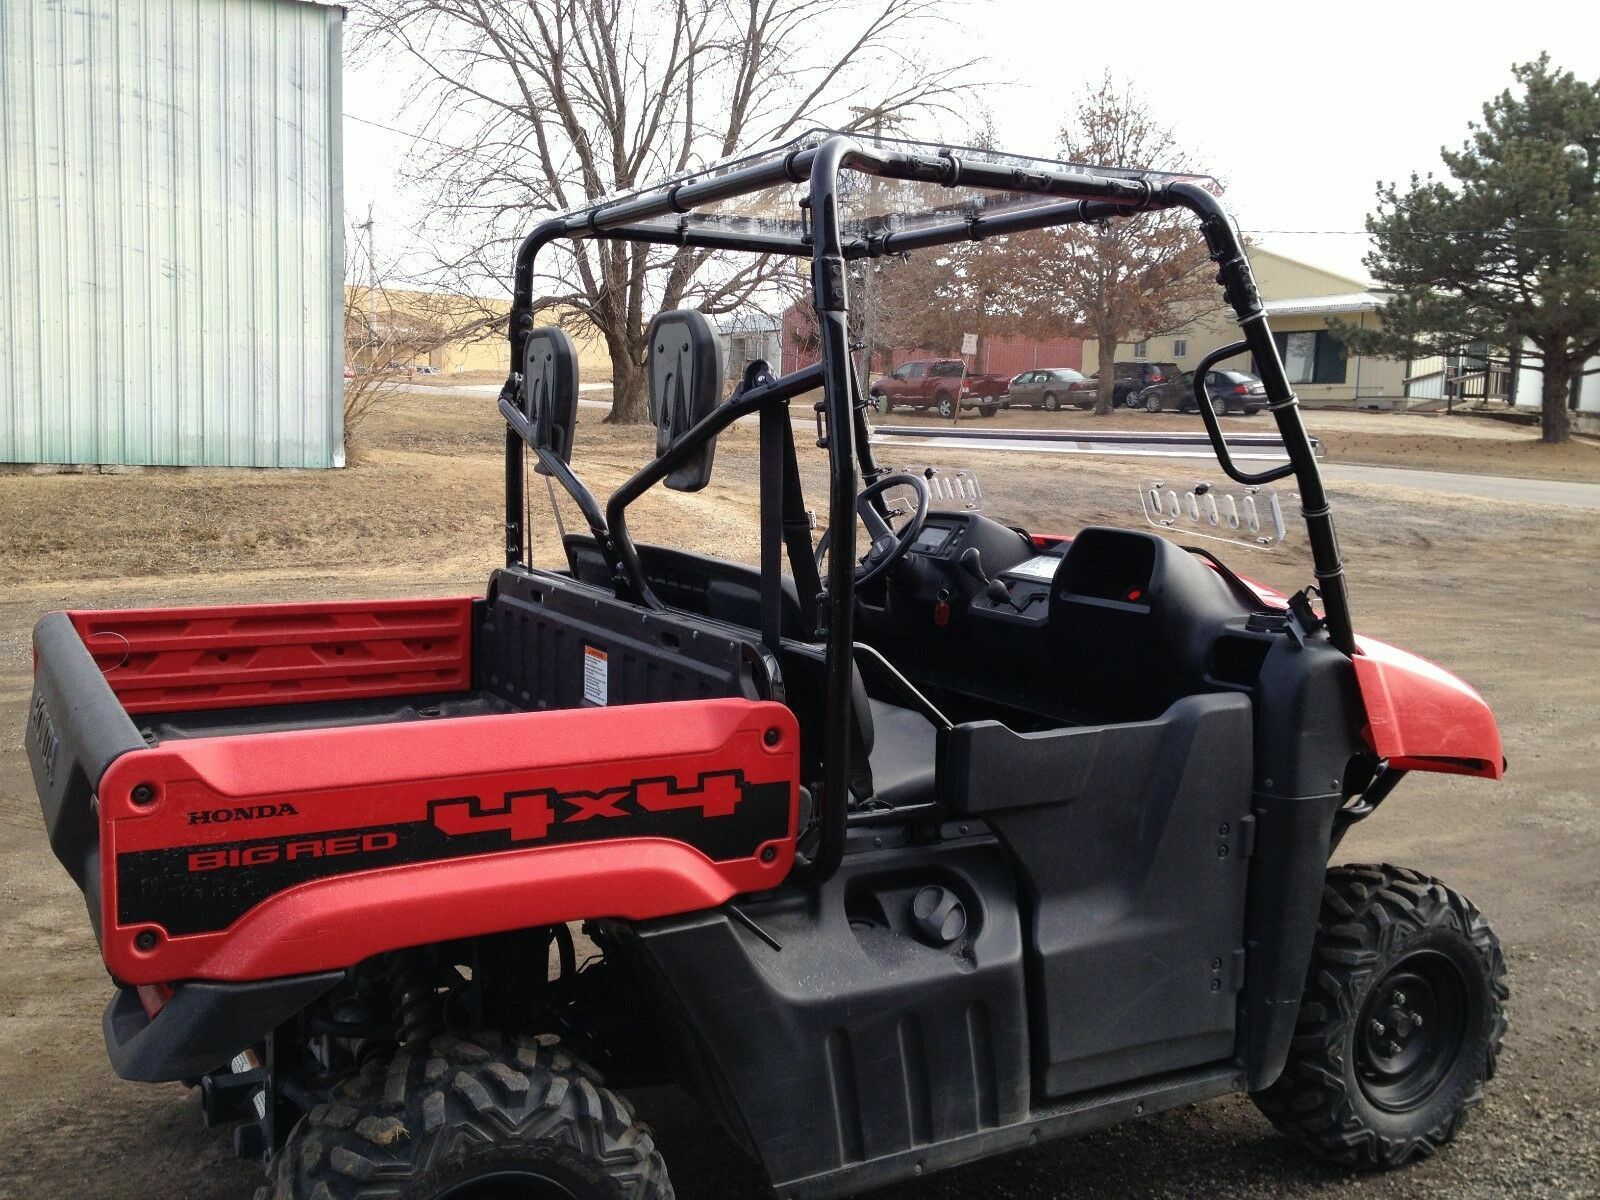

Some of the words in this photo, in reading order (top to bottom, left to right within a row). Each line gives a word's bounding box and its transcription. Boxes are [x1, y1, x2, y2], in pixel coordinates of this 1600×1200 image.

[187, 803, 299, 826] HONDA
[187, 844, 280, 872] BIG
[286, 832, 399, 861] RED
